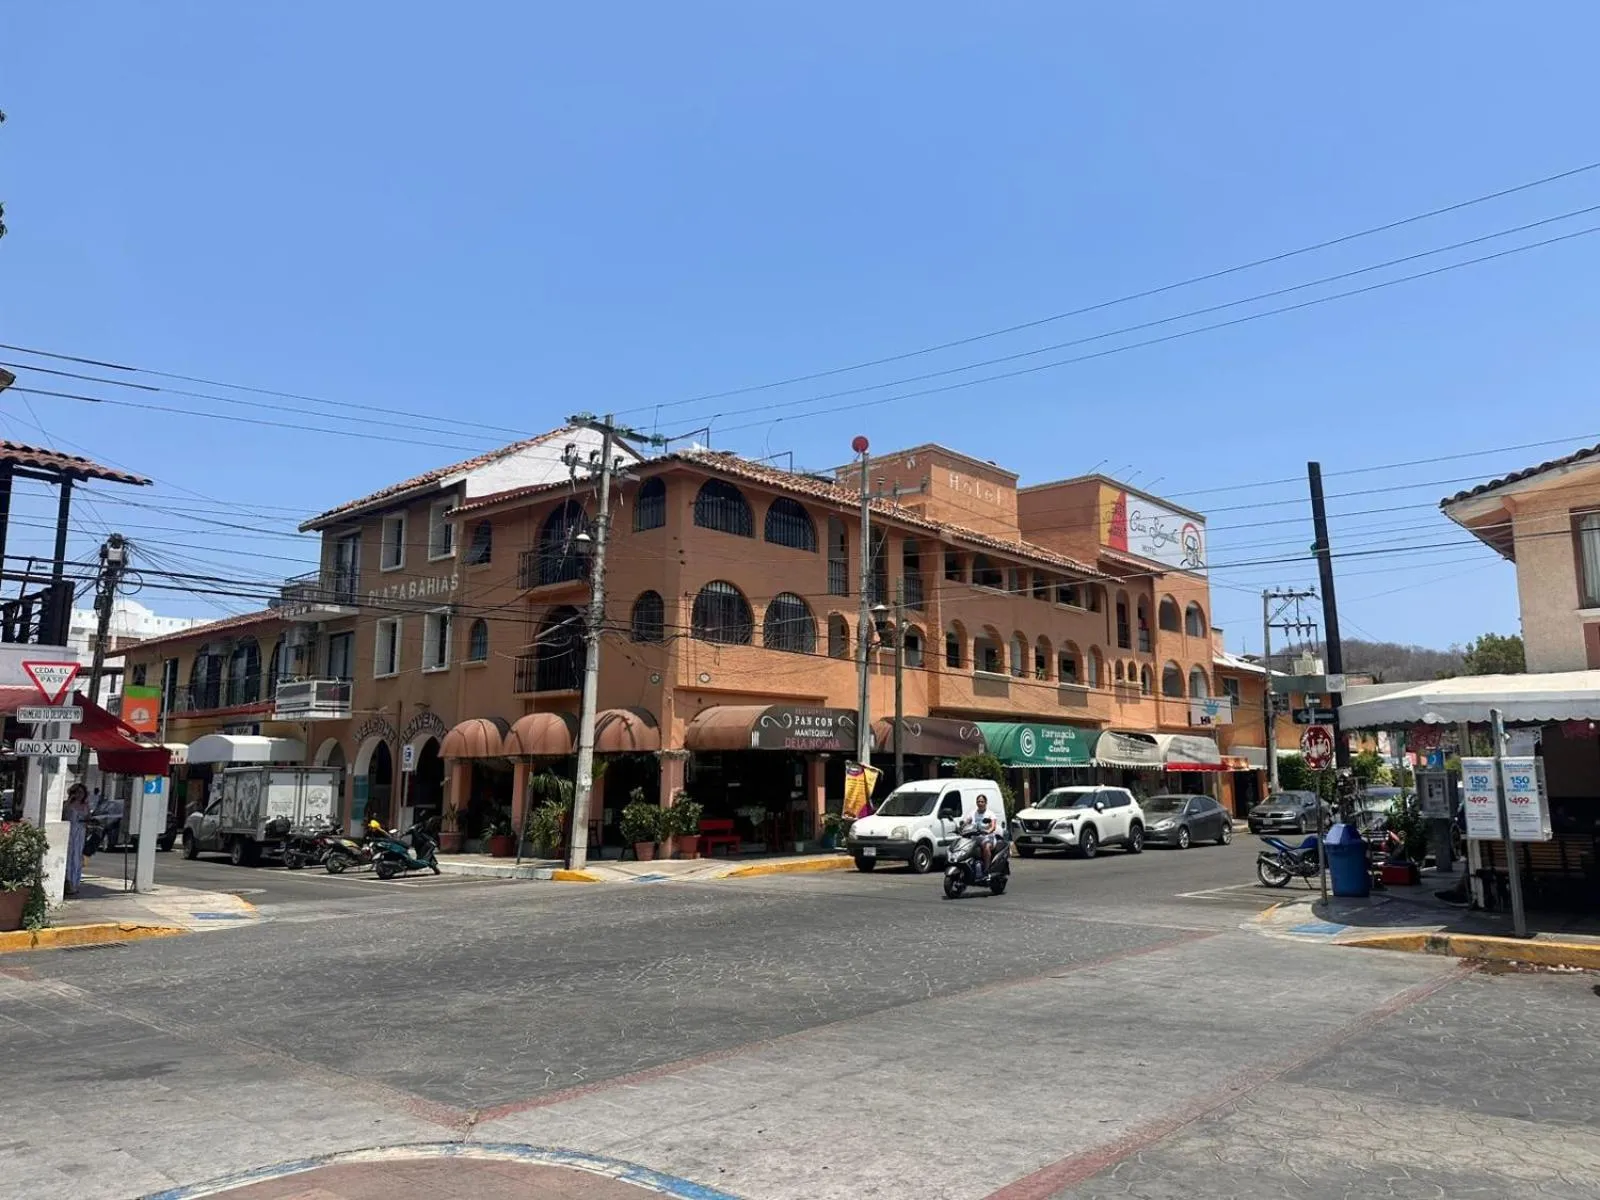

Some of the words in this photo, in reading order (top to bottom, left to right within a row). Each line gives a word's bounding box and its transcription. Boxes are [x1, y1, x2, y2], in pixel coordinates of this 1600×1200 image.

[59, 667, 70, 675] EL
[19, 709, 42, 719] PRIMERO
[795, 715, 812, 725] PAN
[815, 717, 833, 727] CON
[794, 729, 834, 738] MANTEQUILLA
[1041, 728, 1076, 739] Farmacia
[1053, 738, 1065, 746] del
[20, 744, 40, 753] UNO
[43, 743, 52, 754] X
[56, 744, 77, 753] UNO
[1469, 775, 1488, 784] 150
[1510, 775, 1530, 784] 150
